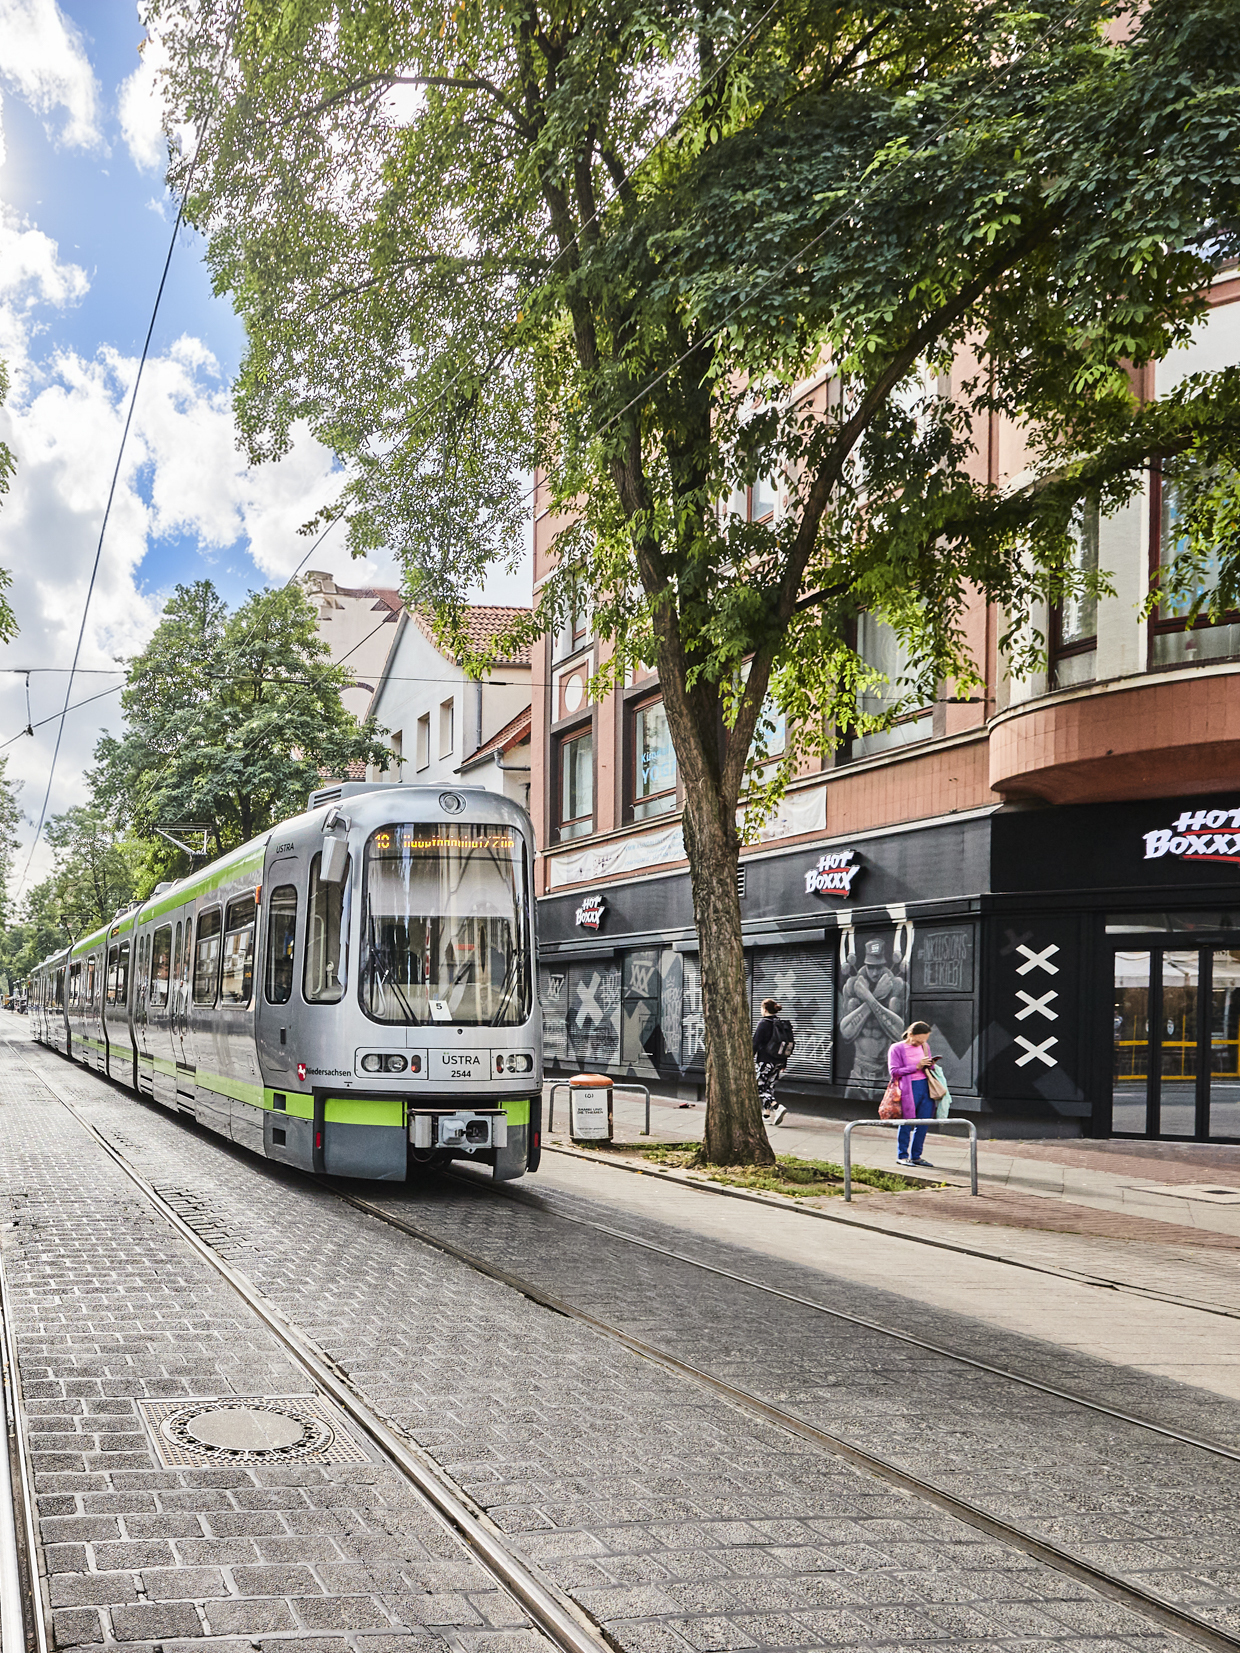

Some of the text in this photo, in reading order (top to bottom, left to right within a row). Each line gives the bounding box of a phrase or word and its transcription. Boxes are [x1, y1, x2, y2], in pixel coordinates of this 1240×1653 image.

[817, 850, 856, 872] HOT
[805, 864, 860, 893] BOXXX
[582, 896, 602, 909] HOT
[442, 1052, 481, 1066] ÜSTRA
[306, 1067, 352, 1077] Niedersachsen
[451, 1070, 472, 1078] 2544
